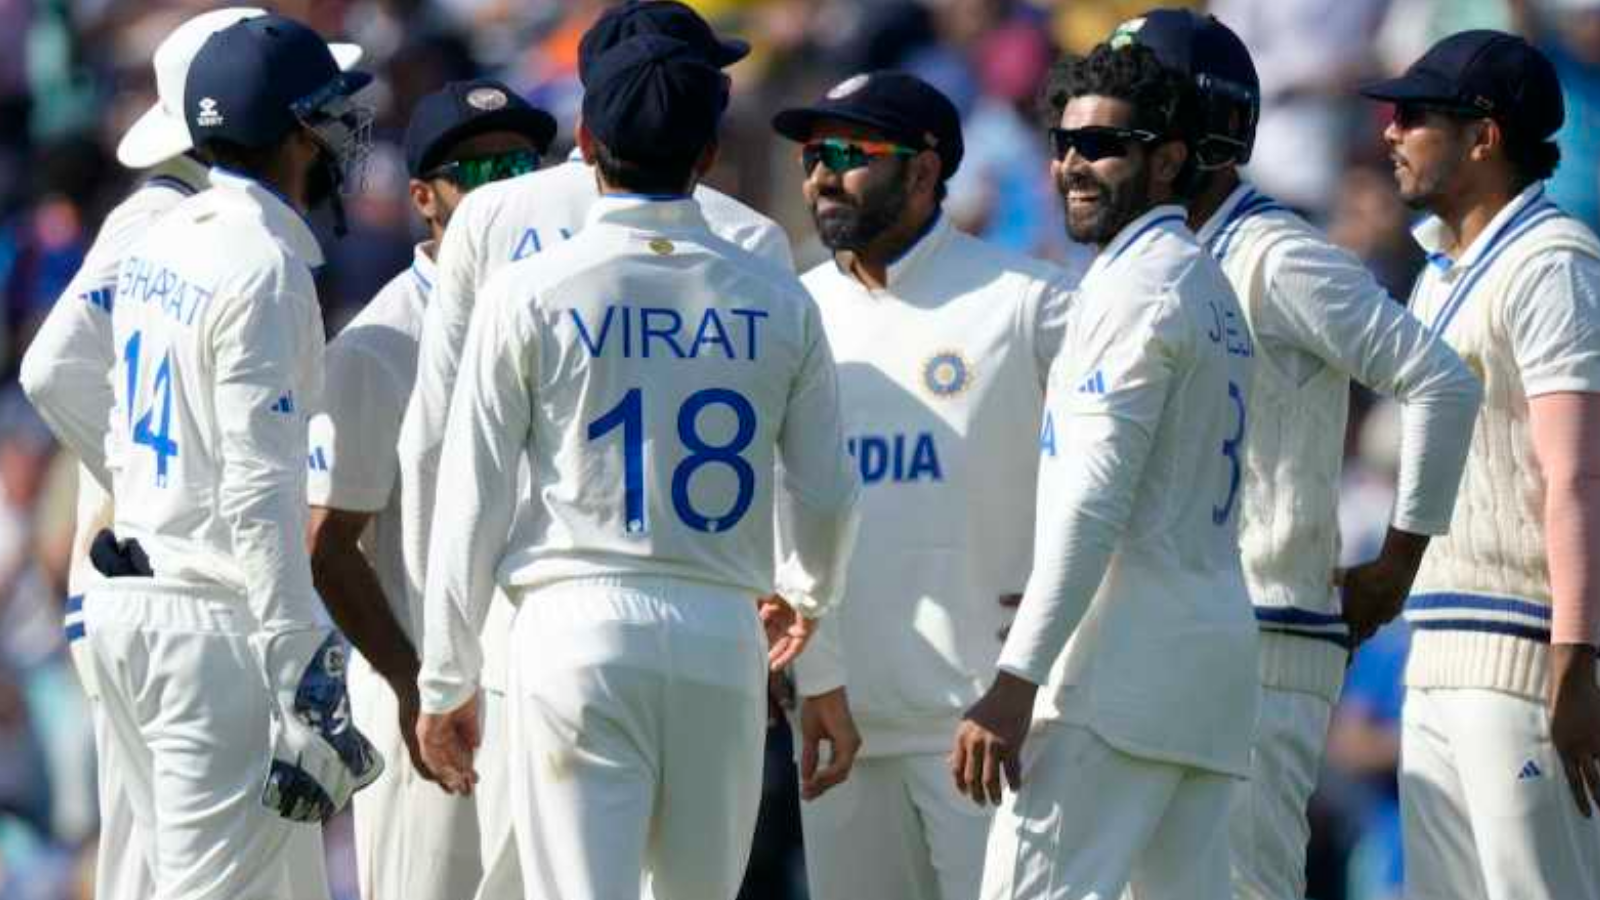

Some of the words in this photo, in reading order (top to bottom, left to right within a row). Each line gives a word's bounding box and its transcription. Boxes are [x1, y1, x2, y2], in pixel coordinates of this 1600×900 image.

[570, 305, 768, 360] VIRAT
[124, 330, 178, 488] 14
[848, 431, 942, 485] DIA
[588, 388, 756, 533] 18
